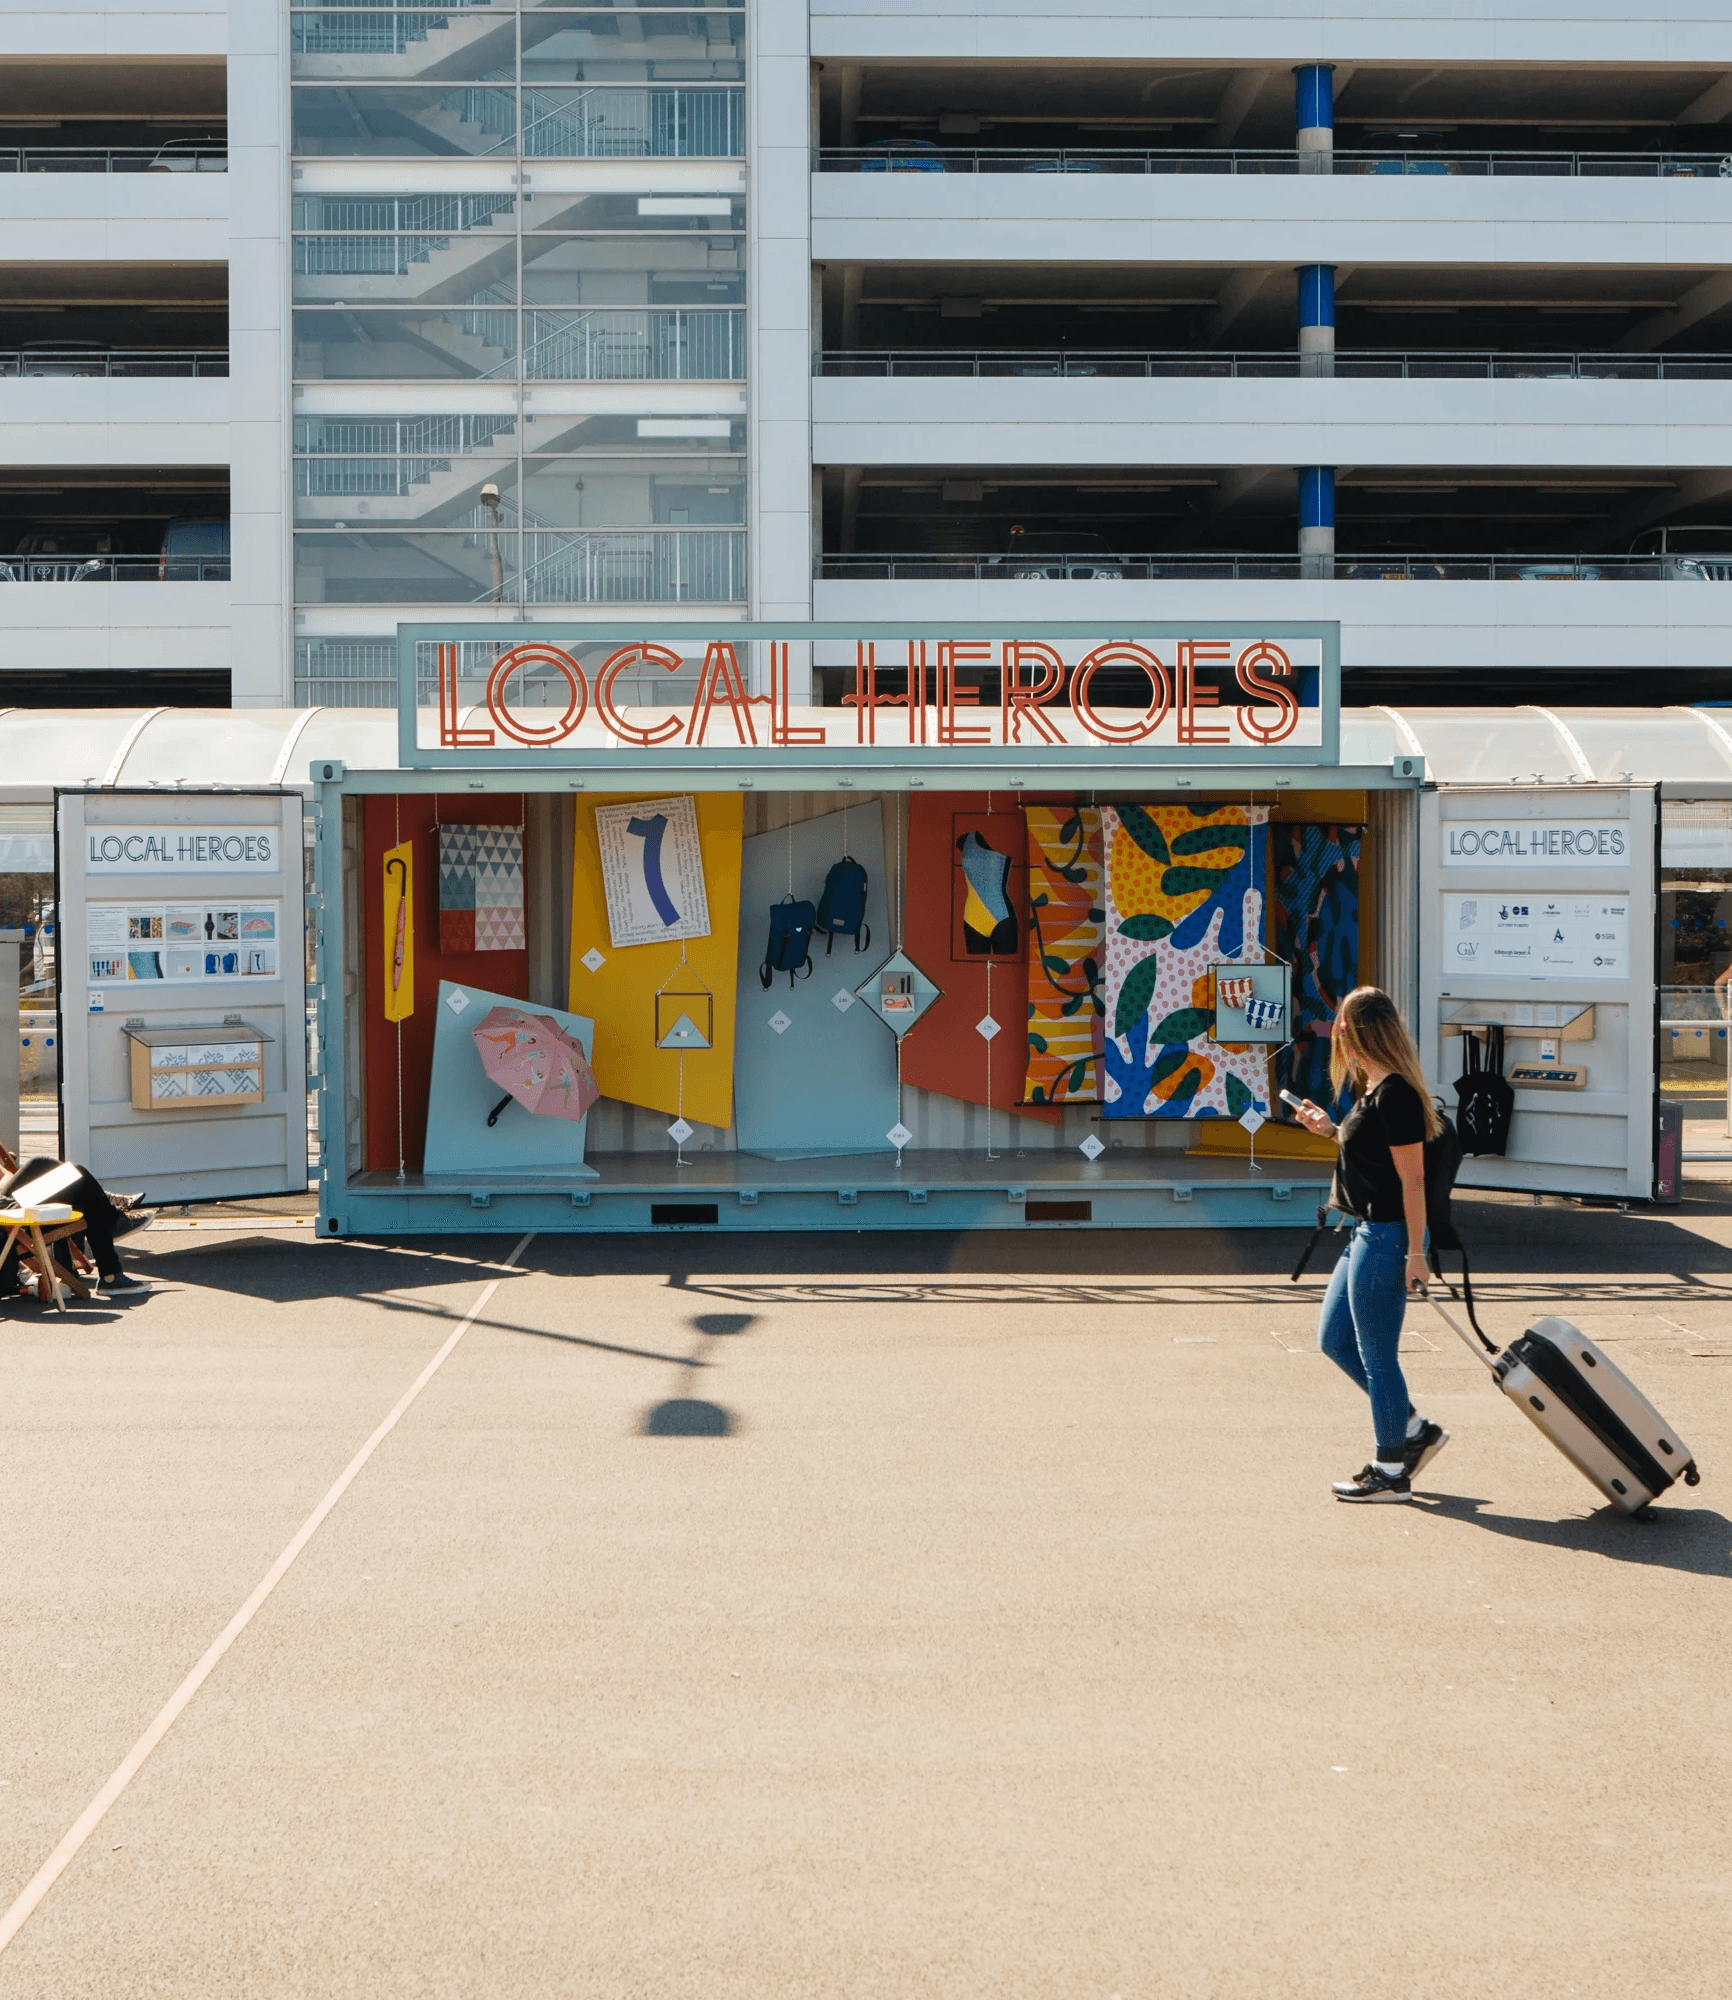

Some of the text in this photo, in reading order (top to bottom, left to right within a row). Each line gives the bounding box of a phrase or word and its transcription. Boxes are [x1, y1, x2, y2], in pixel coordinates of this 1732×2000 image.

[438, 641, 1299, 747] LOCAL HEROES
[90, 835, 271, 862] LOCAL HEROES
[1450, 829, 1625, 855] LOCAL HEROES
